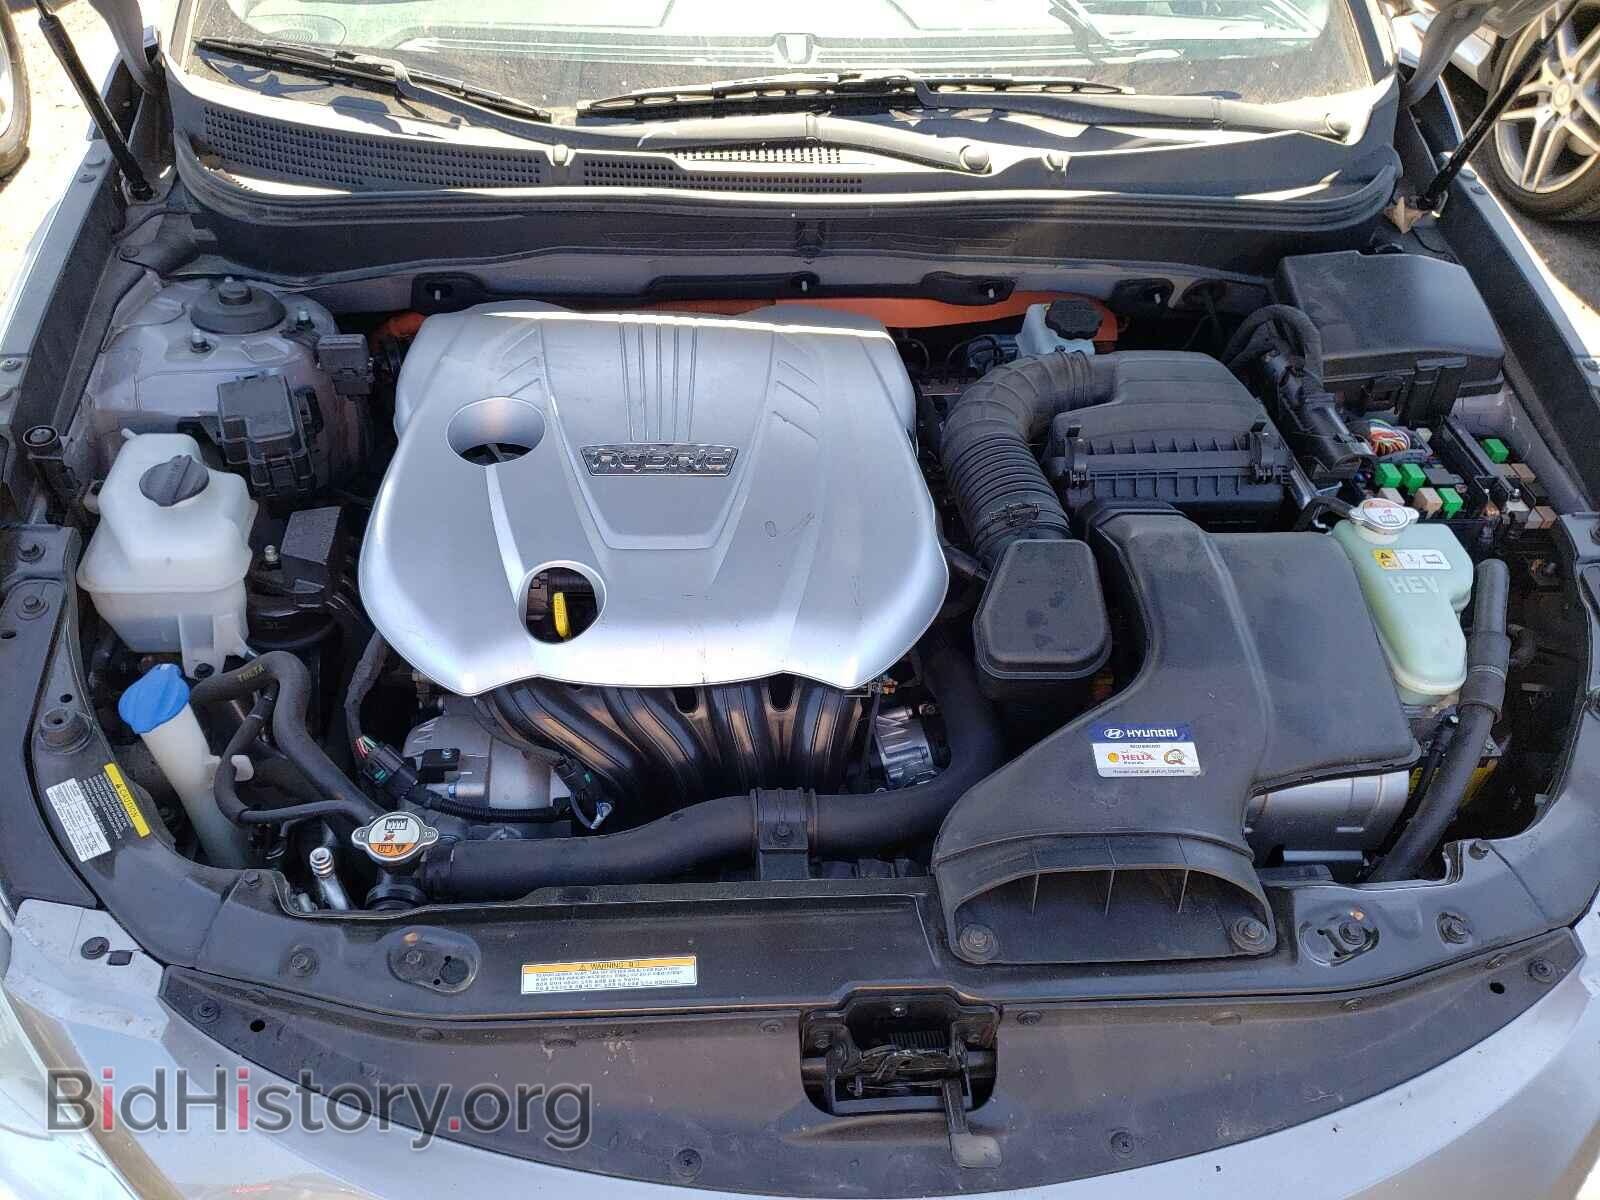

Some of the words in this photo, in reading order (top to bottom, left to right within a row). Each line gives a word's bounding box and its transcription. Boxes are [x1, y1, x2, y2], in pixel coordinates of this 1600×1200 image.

[1387, 575, 1440, 593] HEV
[1126, 728, 1178, 738] HYUNDAI
[1121, 753, 1154, 761] HELIX
[119, 787, 140, 818] CAUTION
[590, 961, 624, 970] WARNING
